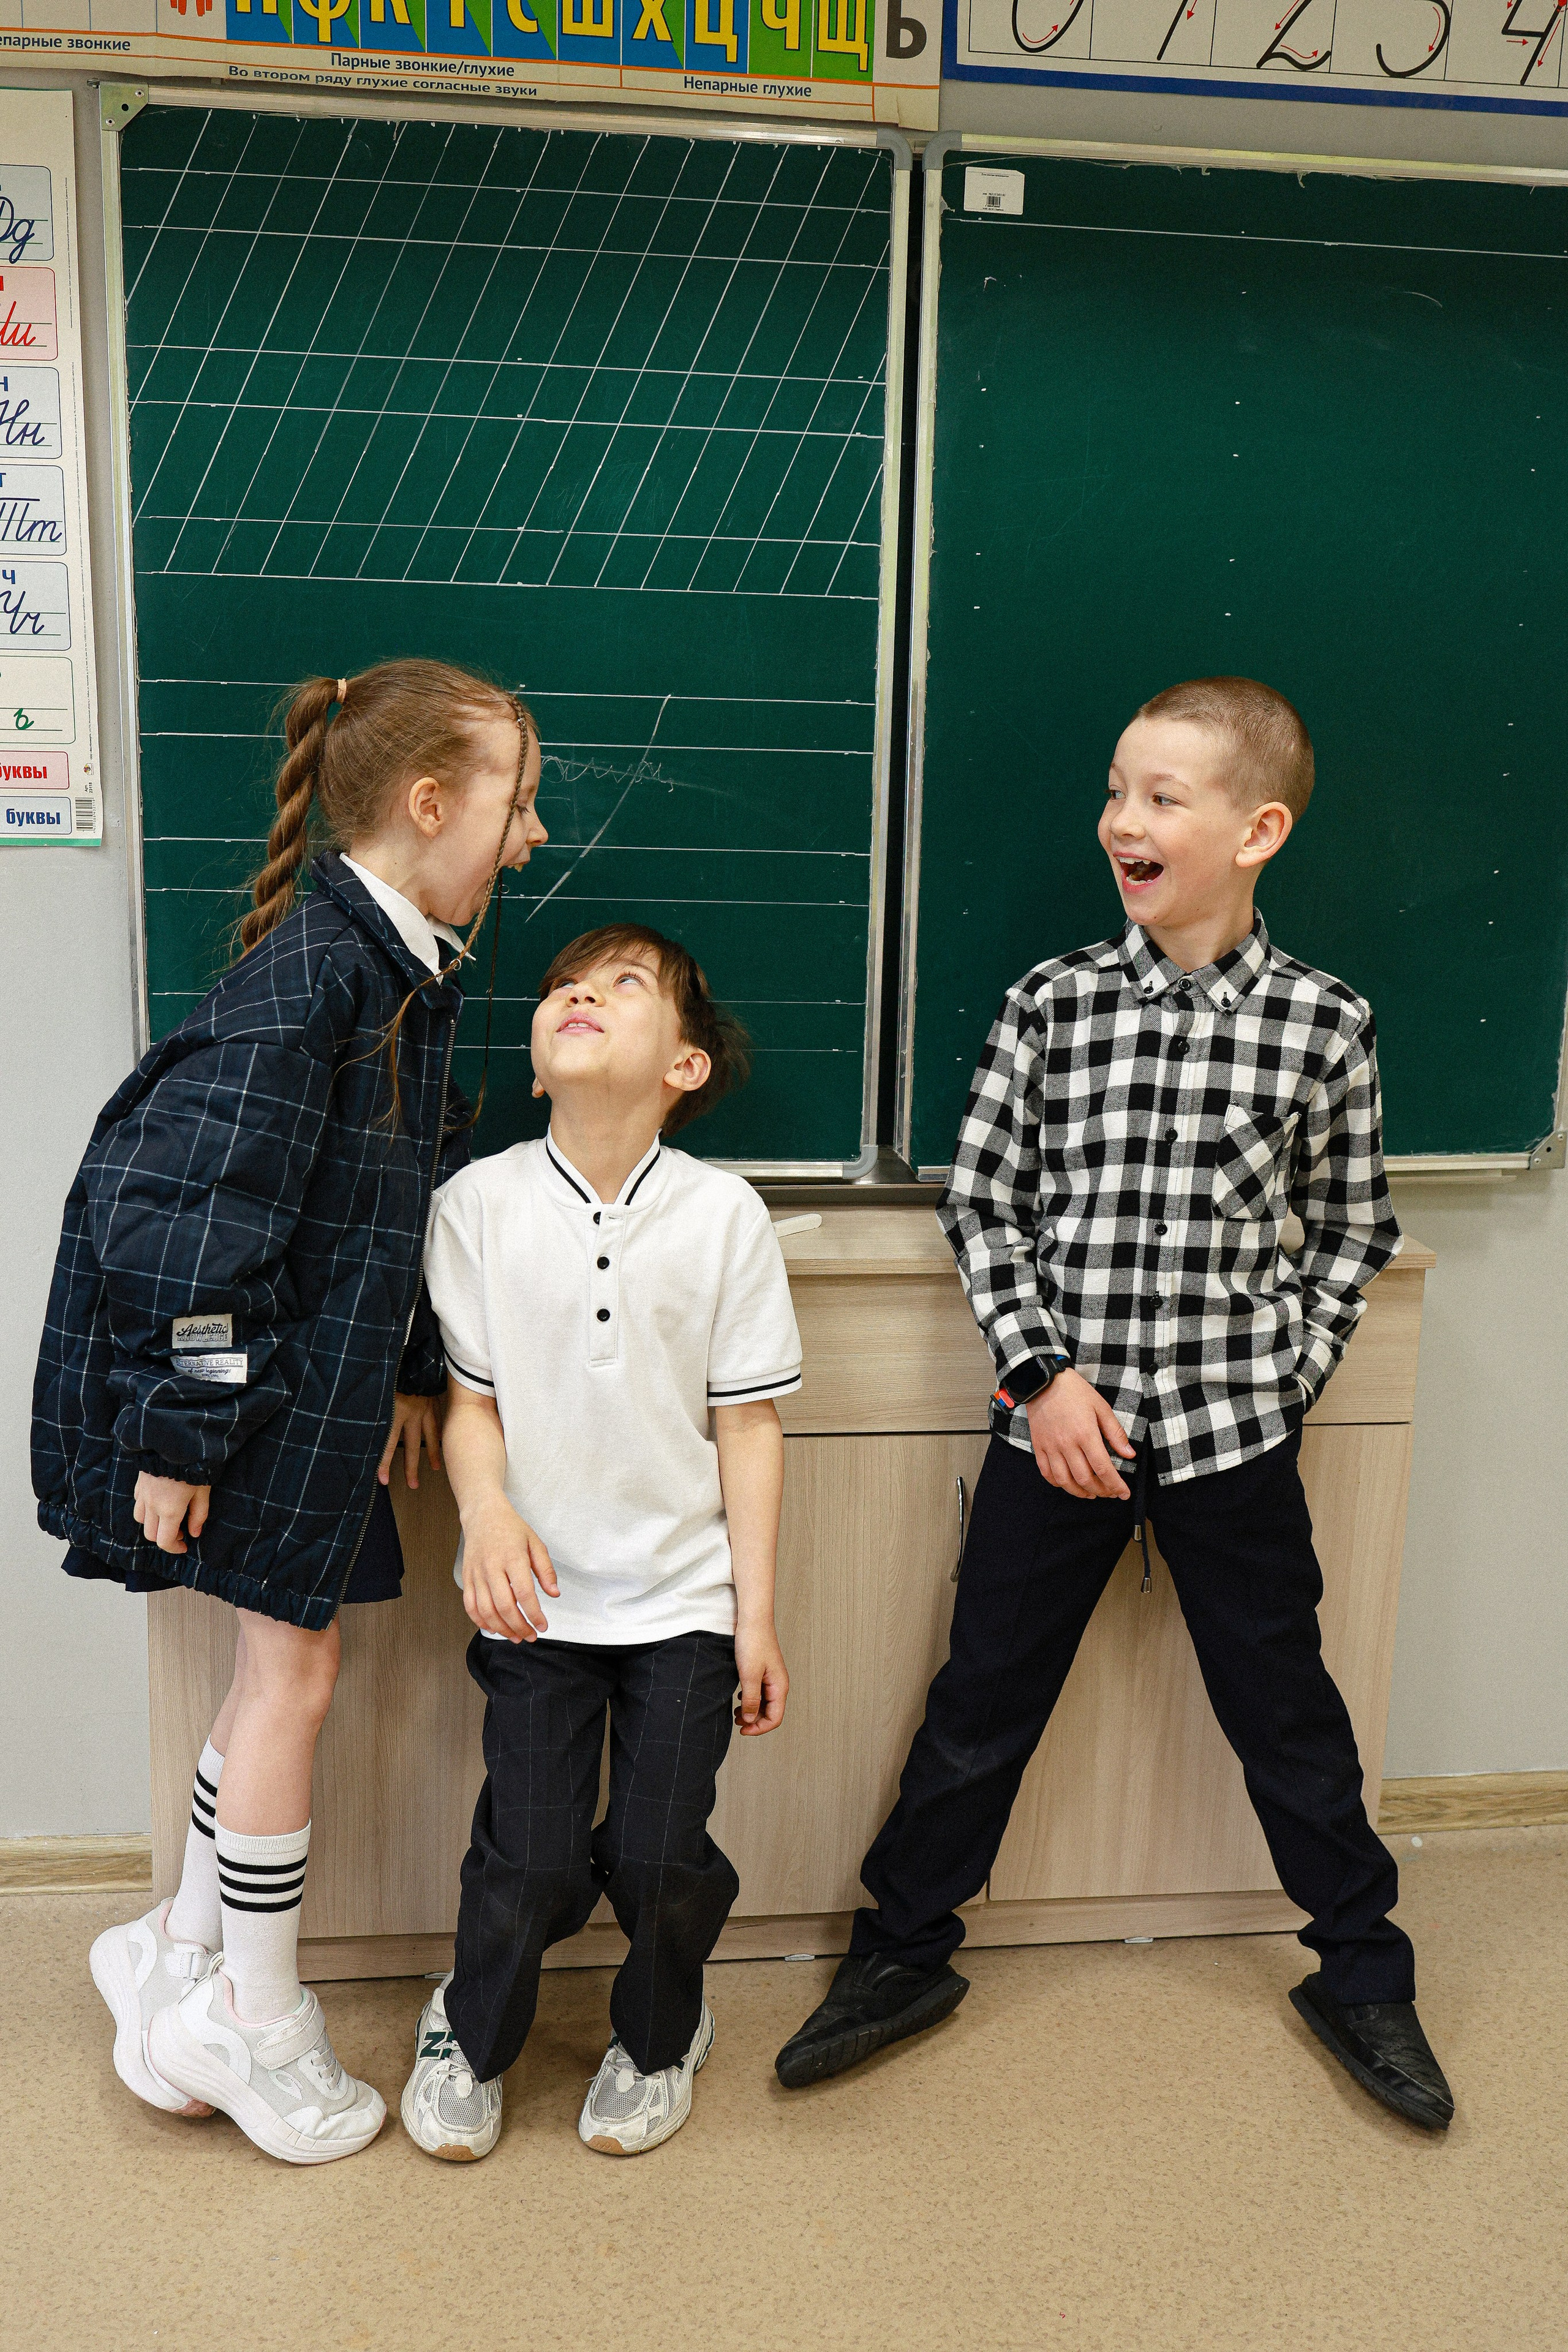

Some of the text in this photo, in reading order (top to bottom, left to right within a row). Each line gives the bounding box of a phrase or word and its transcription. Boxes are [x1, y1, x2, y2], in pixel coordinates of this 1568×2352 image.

[67, 38, 131, 51] звонкие
[331, 53, 514, 77] Парные звонкие/глухие
[228, 66, 537, 96] Во втором ряду глухие согласные звуки
[684, 76, 812, 98] Непарные глухие
[0, 763, 47, 781] уквы
[6, 808, 61, 827] буквы
